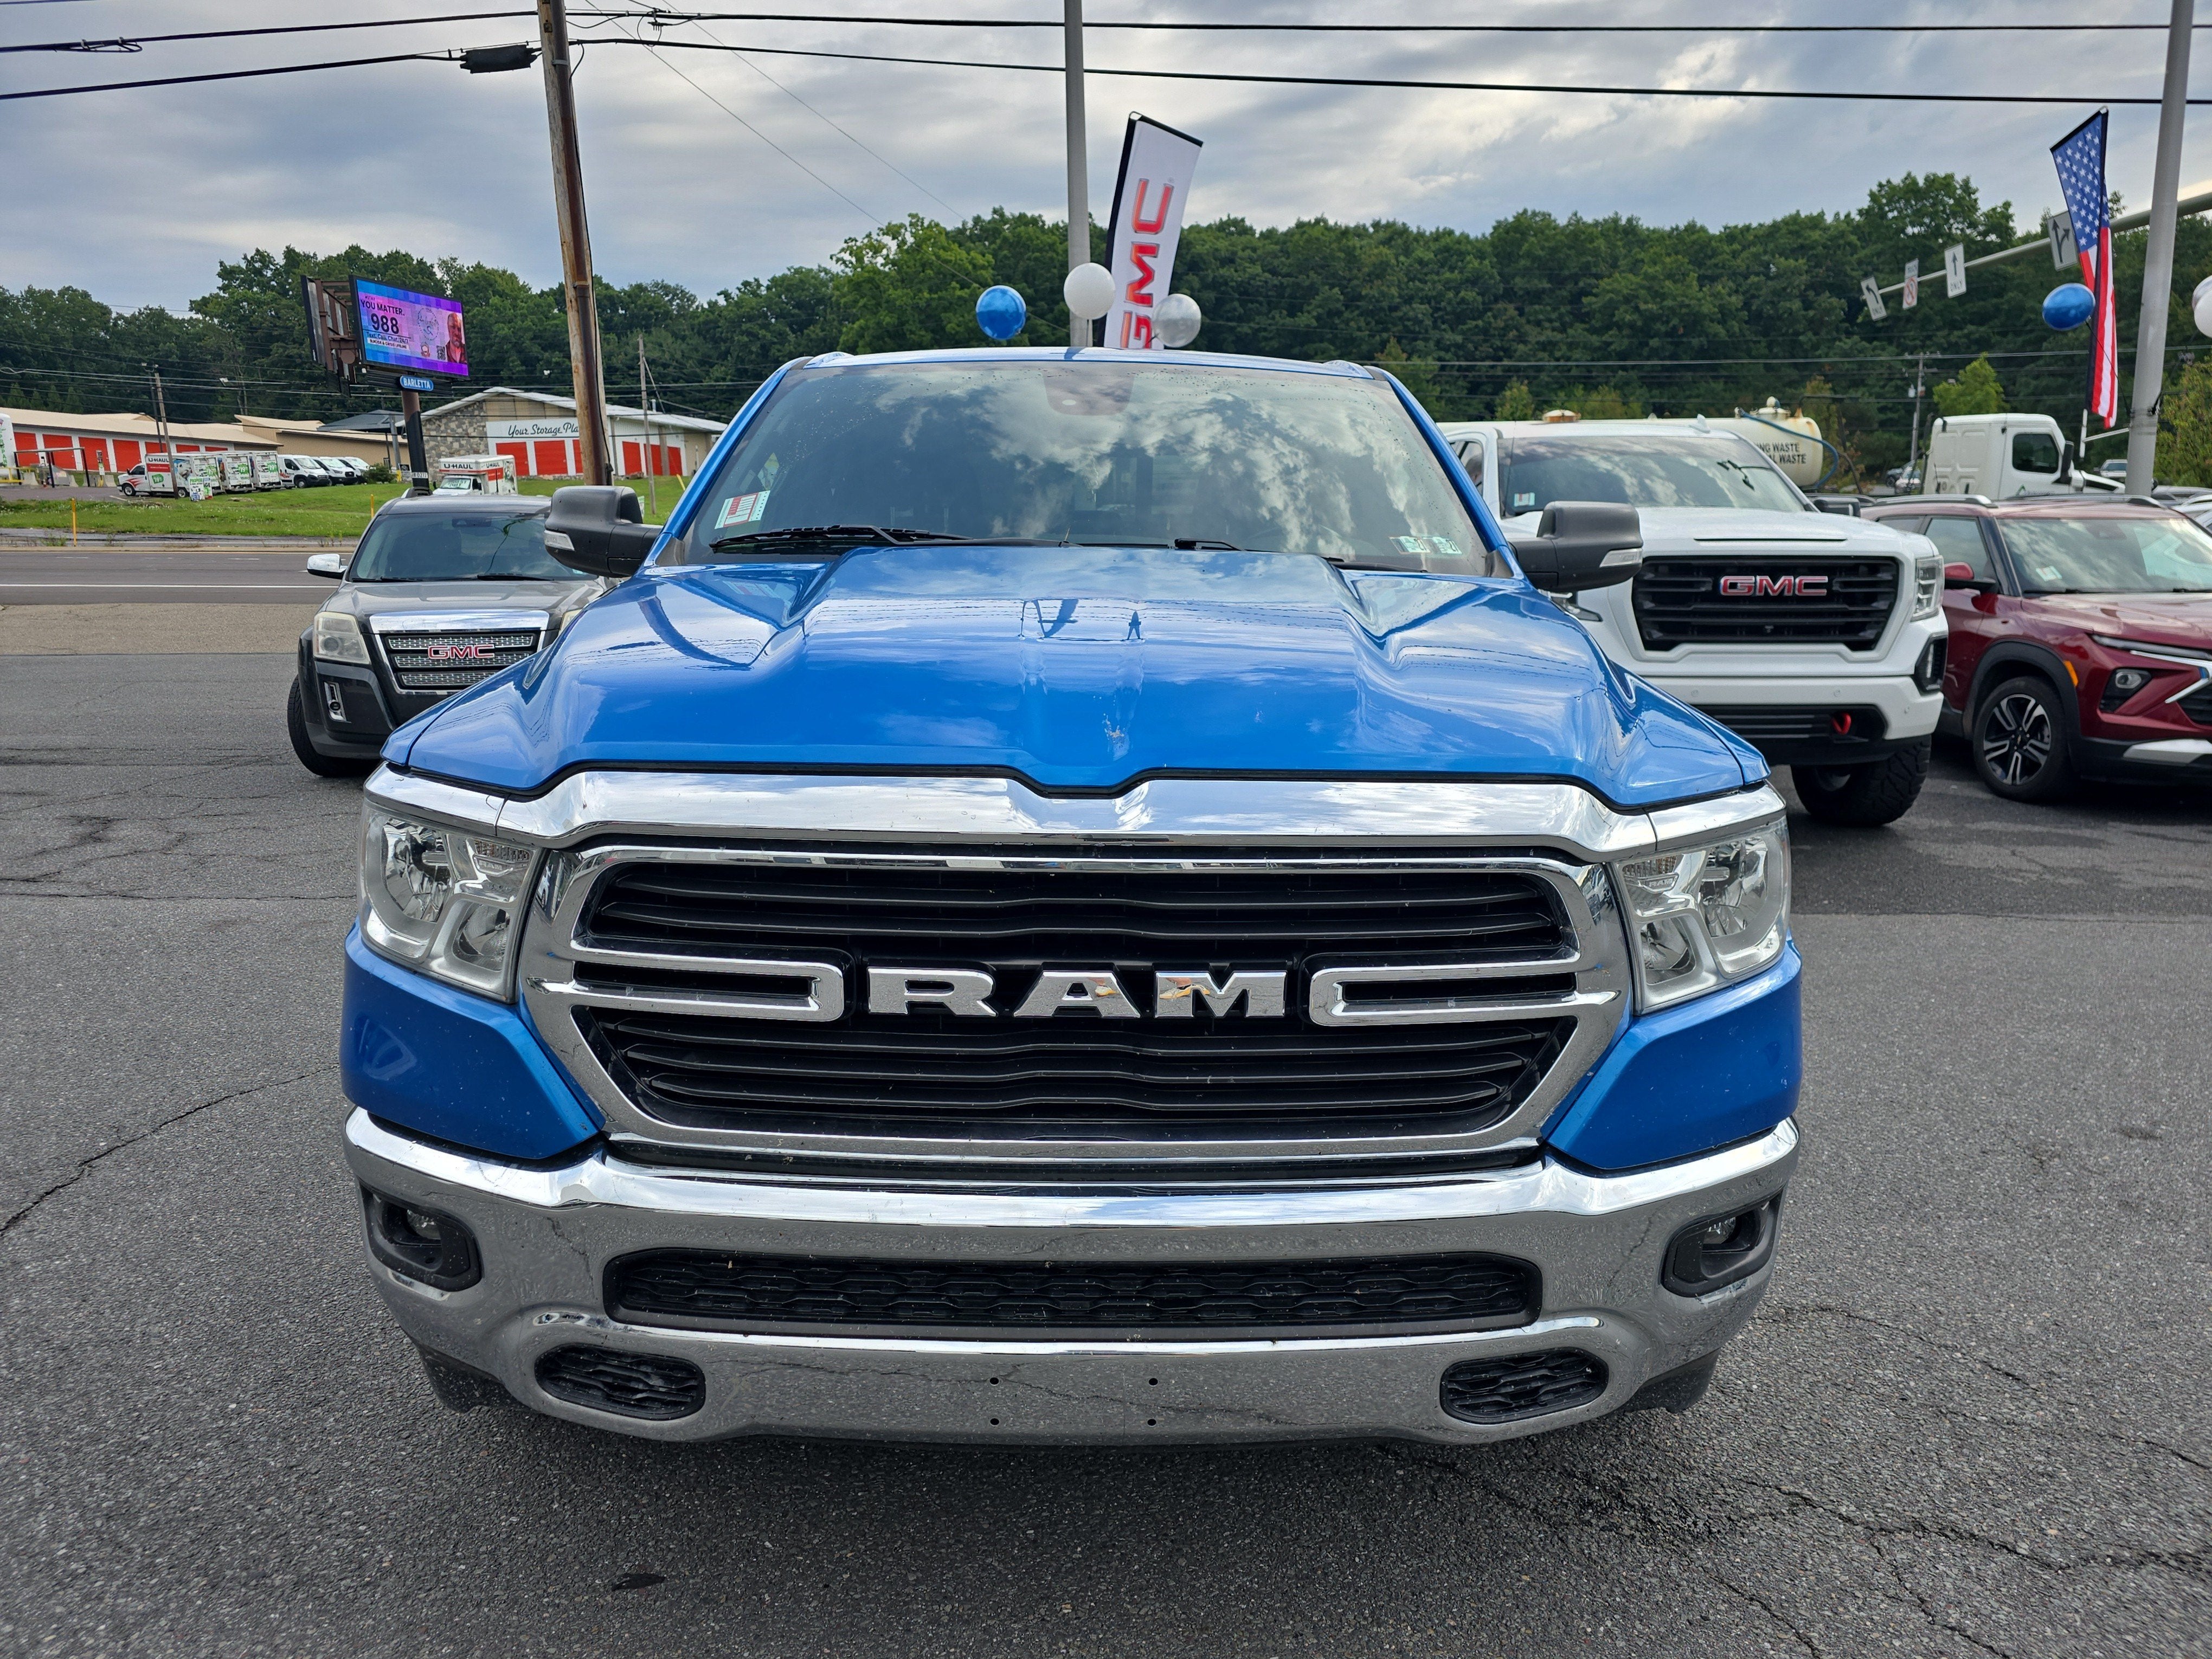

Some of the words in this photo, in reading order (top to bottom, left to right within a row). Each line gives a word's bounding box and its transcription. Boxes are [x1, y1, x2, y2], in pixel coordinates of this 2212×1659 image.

[1120, 178, 1174, 350] GMC
[361, 299, 375, 310] YOU
[377, 303, 405, 316] MATTER.
[370, 313, 399, 334] 988
[403, 377, 431, 389] BARLETTA
[508, 425, 529, 438] Your
[530, 424, 563, 436] Storage
[1772, 442, 1800, 452] WASTE
[1779, 454, 1806, 464] WASTE
[1720, 575, 1829, 596] GMC
[428, 644, 495, 659] GMC
[868, 967, 1287, 1018] RAM
